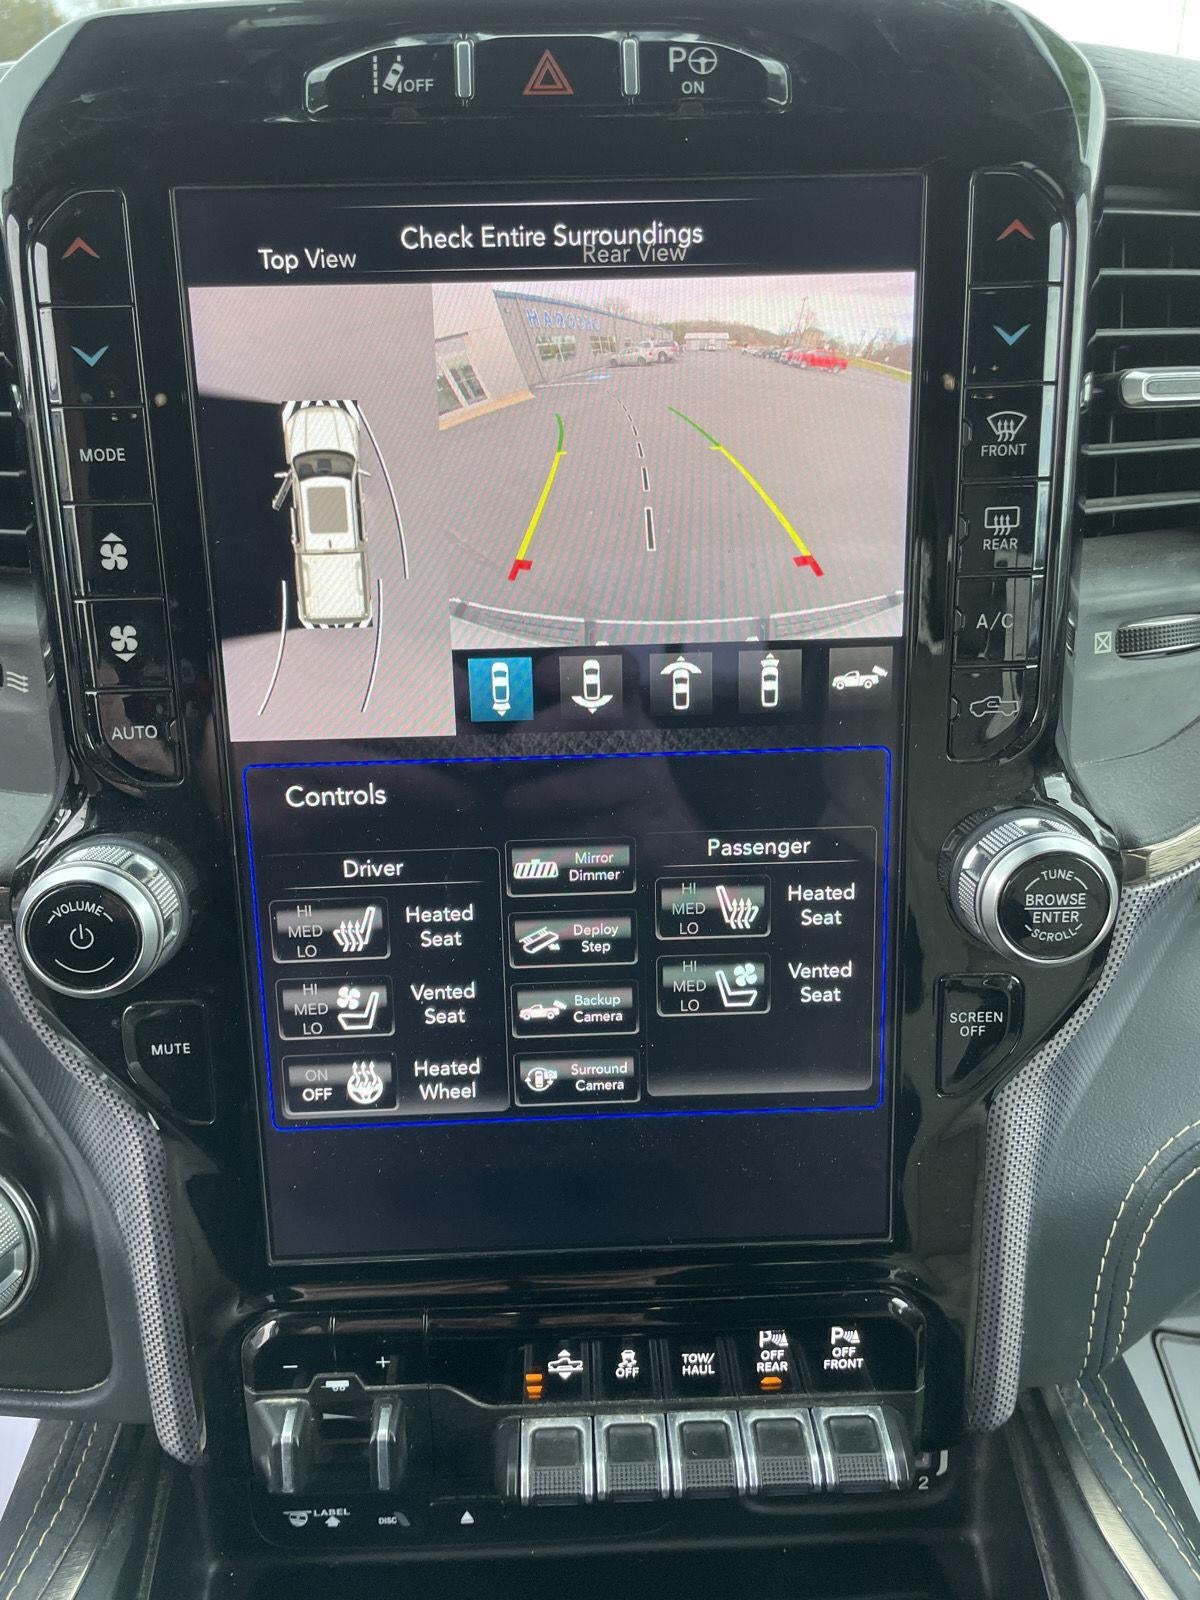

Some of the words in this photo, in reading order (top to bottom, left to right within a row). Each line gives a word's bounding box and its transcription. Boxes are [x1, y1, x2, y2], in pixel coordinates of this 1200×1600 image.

[403, 79, 435, 93] OFF
[681, 80, 705, 94] ON
[401, 225, 474, 250] Check
[481, 224, 546, 249] Entire
[553, 220, 704, 248] Surroundings
[257, 248, 299, 274] Top
[304, 247, 358, 270] View
[582, 245, 630, 264] Rear
[636, 244, 688, 263] View
[79, 447, 127, 462] MODE
[980, 443, 1028, 457] FRONT
[982, 537, 1019, 551] REAR
[975, 611, 1014, 631] A/C
[111, 724, 159, 740] AUTO
[285, 782, 388, 808] Controls
[706, 838, 812, 859] Passenger
[574, 851, 614, 865] Mirror
[342, 859, 405, 879] Driver
[568, 869, 621, 882] Dimmer
[1040, 868, 1075, 882] TUNE
[681, 882, 697, 895] HI
[787, 882, 856, 902] Heated
[1025, 892, 1087, 907] BROWSE
[52, 900, 105, 918] VOLUME
[296, 905, 312, 918] HI
[405, 903, 474, 924] Heated
[671, 902, 706, 916] MED
[800, 909, 843, 926] Seat
[1032, 911, 1080, 924] ENTER
[288, 925, 323, 939] MED
[573, 923, 619, 938] Deploy
[679, 922, 699, 935] LO
[1030, 927, 1078, 942] SCROLL
[420, 931, 463, 948] Seat
[297, 945, 318, 958] LO
[581, 941, 611, 955] Step
[682, 960, 697, 973] HI
[787, 960, 853, 980] Vented
[302, 983, 318, 996] HI
[410, 981, 476, 1001] Vented
[672, 980, 707, 993] MED
[574, 994, 621, 1008] Backup
[800, 986, 842, 1003] Seat
[294, 1002, 329, 1016] MED
[680, 999, 700, 1012] LO
[424, 1008, 466, 1025] Seat
[573, 1011, 623, 1023] Camera
[949, 1011, 1003, 1024] SCREEN
[302, 1022, 323, 1035] LO
[959, 1025, 986, 1037] OFF
[151, 1042, 191, 1056] MUTE
[413, 1057, 481, 1078] Heated
[571, 1062, 628, 1075] Surround
[305, 1069, 329, 1082] ON
[419, 1081, 477, 1101] Wheel
[575, 1079, 625, 1092] Camera
[302, 1087, 333, 1102] OFF
[682, 1352, 715, 1364] TOW/
[760, 1350, 785, 1362] OFF
[832, 1346, 857, 1358] OFF
[682, 1364, 716, 1377] HAUL
[756, 1361, 788, 1373] REAR
[824, 1358, 864, 1370] FRONT
[615, 1366, 640, 1378] OFF
[918, 1476, 929, 1490] 2
[313, 1508, 351, 1517] LABEL
[378, 1516, 397, 1525] DISC
